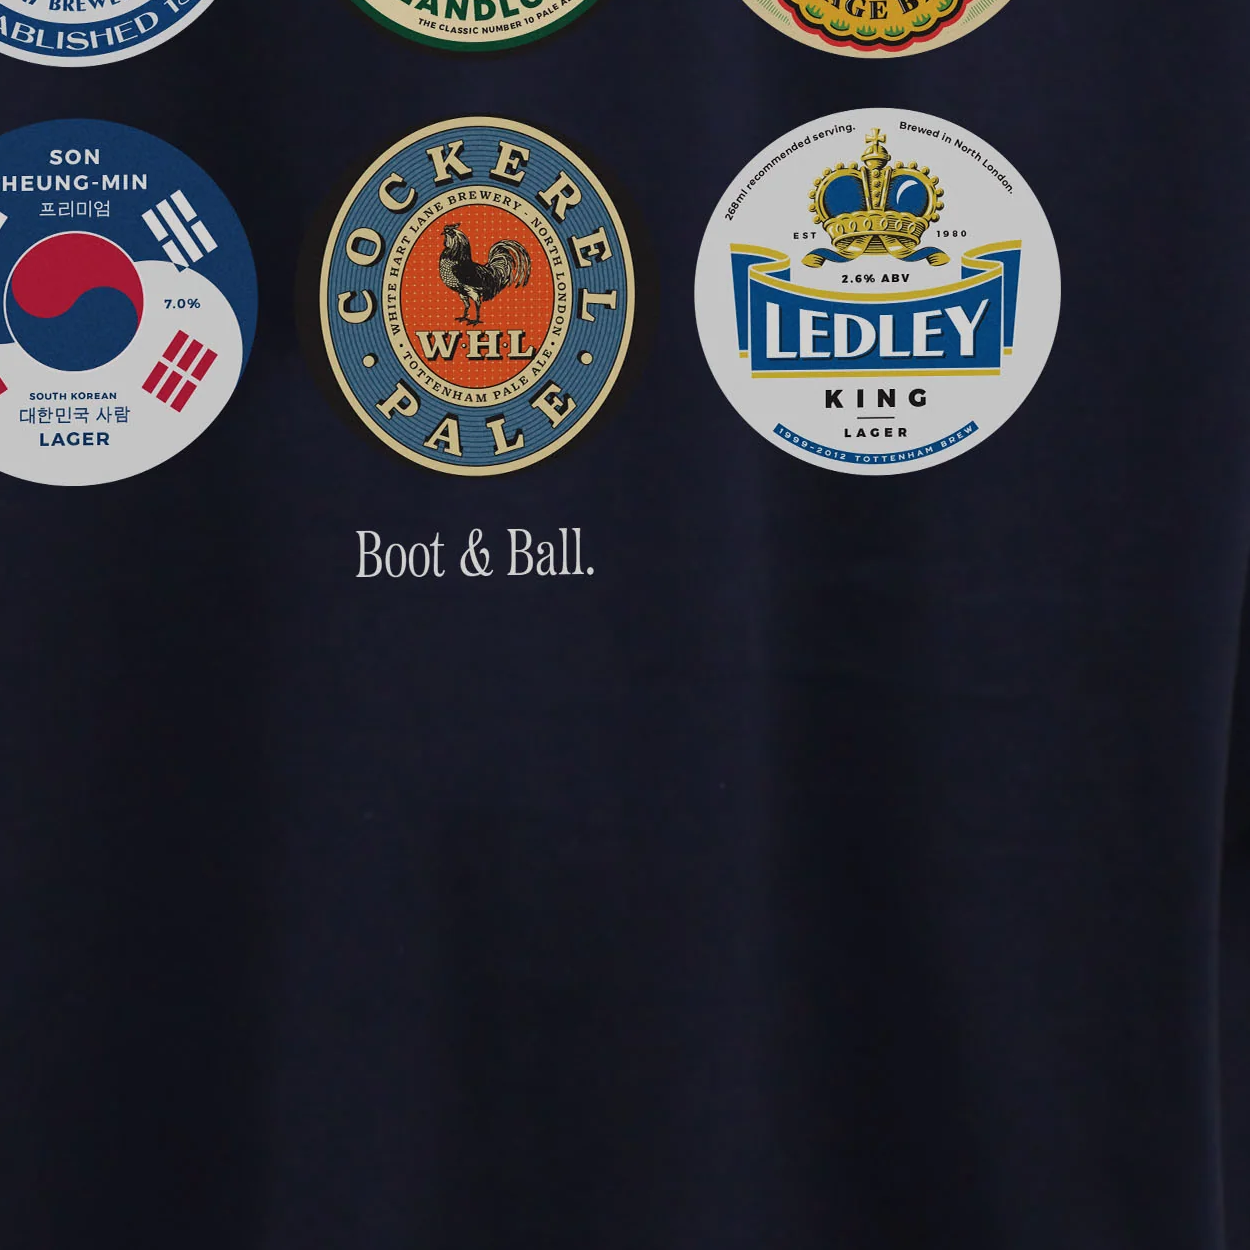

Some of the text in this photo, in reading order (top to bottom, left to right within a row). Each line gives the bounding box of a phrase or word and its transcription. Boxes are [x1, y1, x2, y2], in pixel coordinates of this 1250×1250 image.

[418, 18, 436, 29] THE
[439, 24, 479, 34] CLASSIC
[482, 21, 522, 34] NUMBER
[524, 17, 535, 25] 10
[536, 4, 559, 20] PALE
[49, 148, 100, 166] SON
[899, 120, 1013, 194] Brewed in North London.
[2, 173, 148, 192] HEUNG-MIN
[724, 124, 856, 221] 268ml recommended serving.
[39, 199, 111, 218] 프리미엄
[337, 139, 618, 324] COCKEREL
[793, 232, 817, 240] EST
[936, 230, 967, 238] 1980
[388, 190, 522, 335] WHITE HART LANE BREWERY
[530, 216, 567, 336] NORTH LONDON
[841, 273, 910, 284] 2.6% ABV
[164, 298, 201, 310] 7.0%
[765, 298, 990, 360] LEDLEY
[402, 349, 552, 402] TOTTENHAM PALE ALE
[29, 392, 117, 401] SOUTH KOREAN
[825, 388, 927, 408] KING
[19, 406, 131, 424] 대한민국 사람
[375, 381, 577, 457] PALE
[39, 432, 110, 447] LAGER
[844, 428, 907, 438] LAGER
[778, 425, 973, 463] 1999-2012 TOTTENHAM BREW
[355, 527, 594, 577] Boot & Ball.
